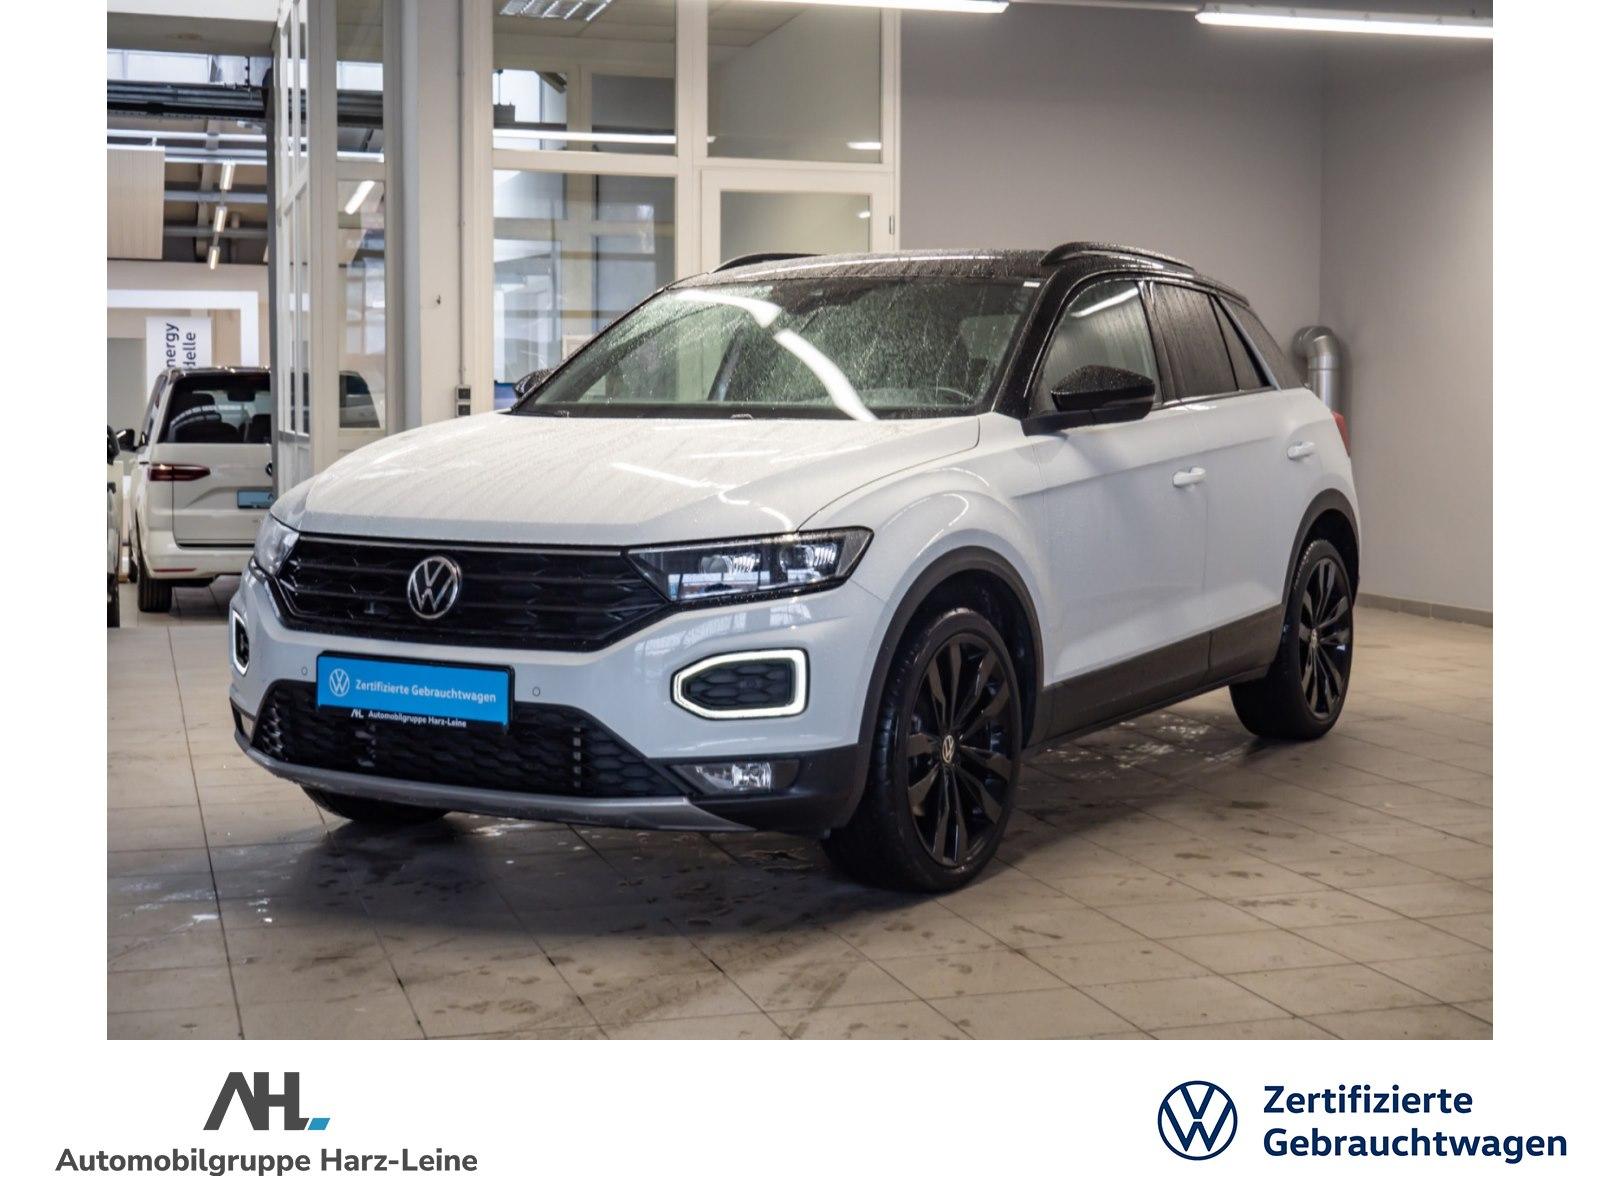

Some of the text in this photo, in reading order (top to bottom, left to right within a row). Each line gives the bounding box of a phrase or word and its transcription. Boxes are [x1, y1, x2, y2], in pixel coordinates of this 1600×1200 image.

[355, 679, 410, 696] Zertifizierte
[411, 684, 497, 705] Gebrauchtwagen
[368, 710, 427, 725] Automobilgruppe
[428, 716, 467, 728] Harz-Leine
